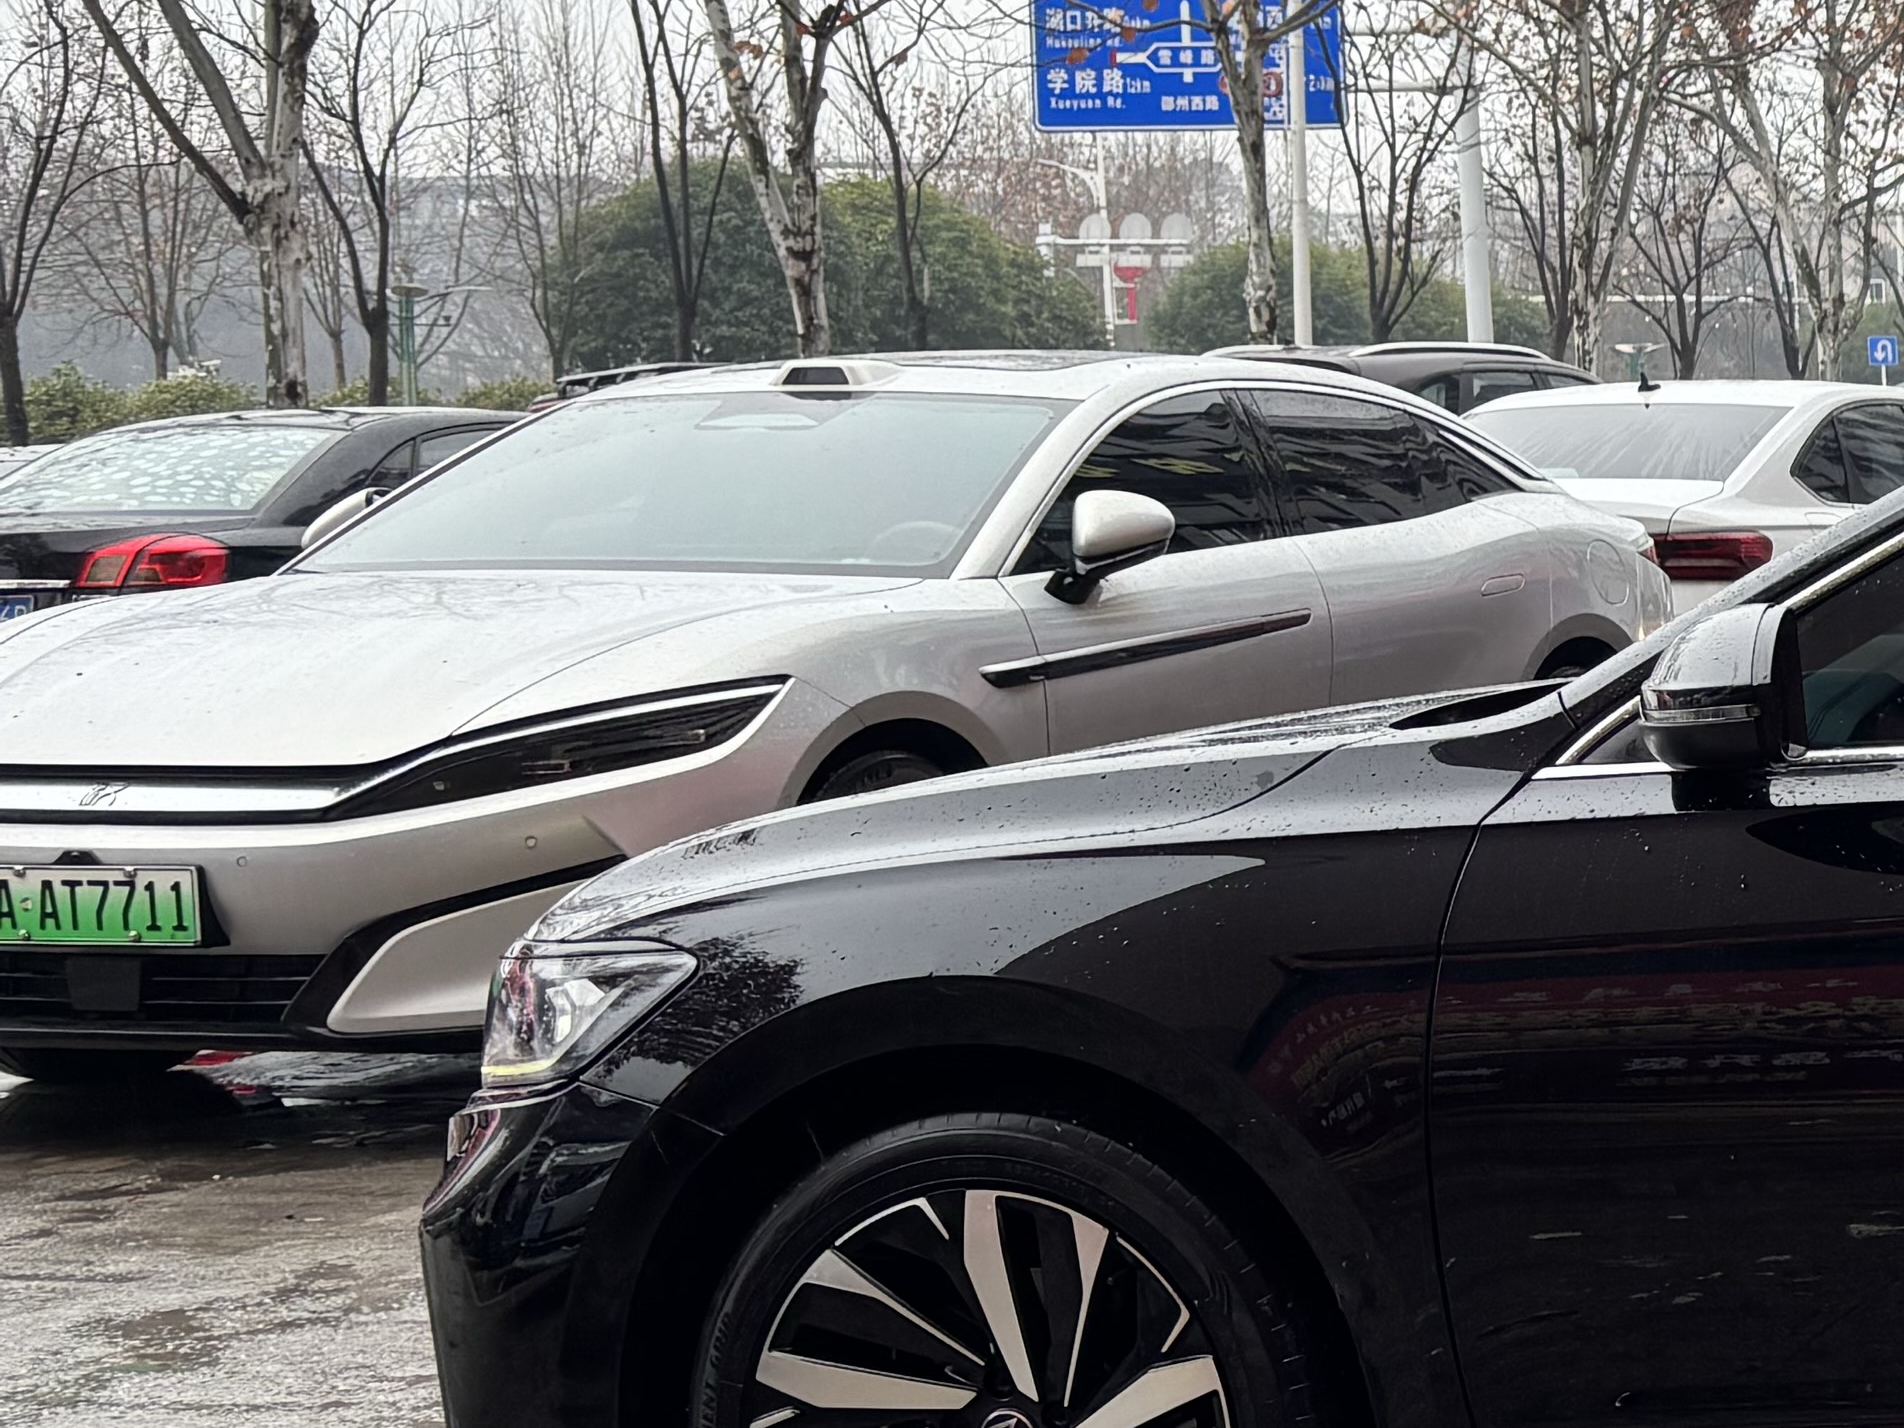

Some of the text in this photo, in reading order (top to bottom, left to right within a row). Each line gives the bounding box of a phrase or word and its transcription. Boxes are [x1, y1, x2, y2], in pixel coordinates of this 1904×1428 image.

[1046, 68, 1124, 95] 学院路
[38, 879, 189, 932] AT7711
